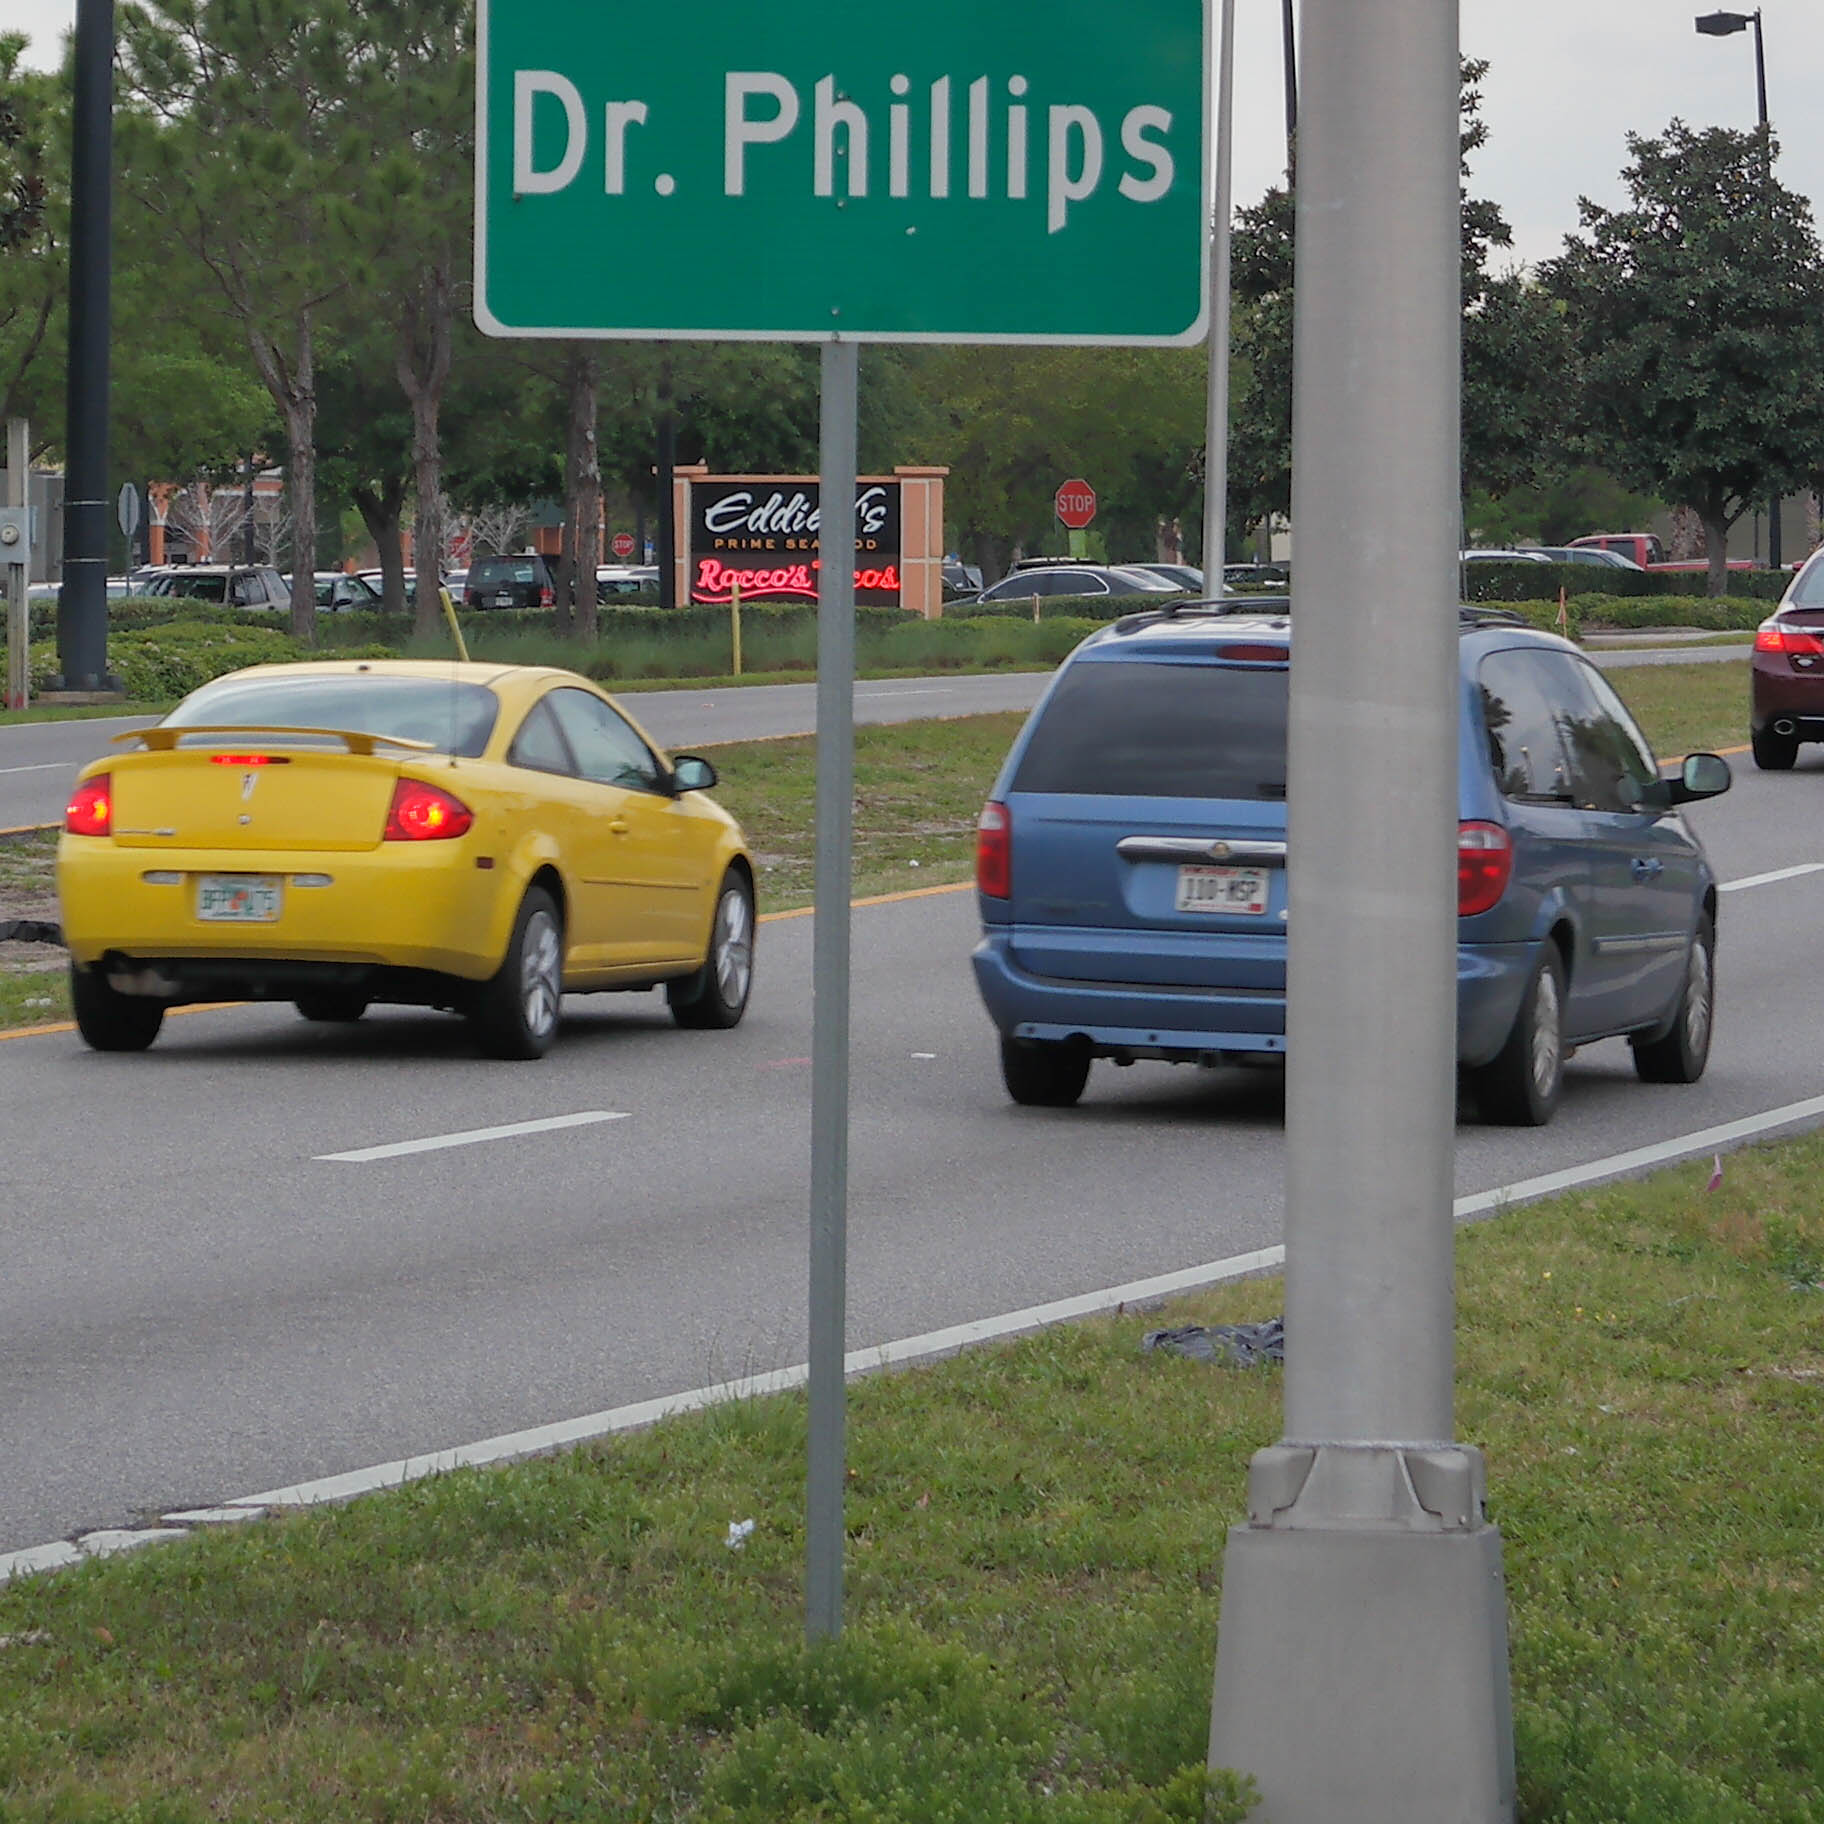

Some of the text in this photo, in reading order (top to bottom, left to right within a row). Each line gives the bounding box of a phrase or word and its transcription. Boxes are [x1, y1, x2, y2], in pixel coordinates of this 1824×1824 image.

[512, 69, 1176, 235] Dr. Phillips
[1059, 495, 1093, 513] STOP
[714, 538, 877, 550] PRIME SEAOD
[696, 558, 813, 593] Rocco's
